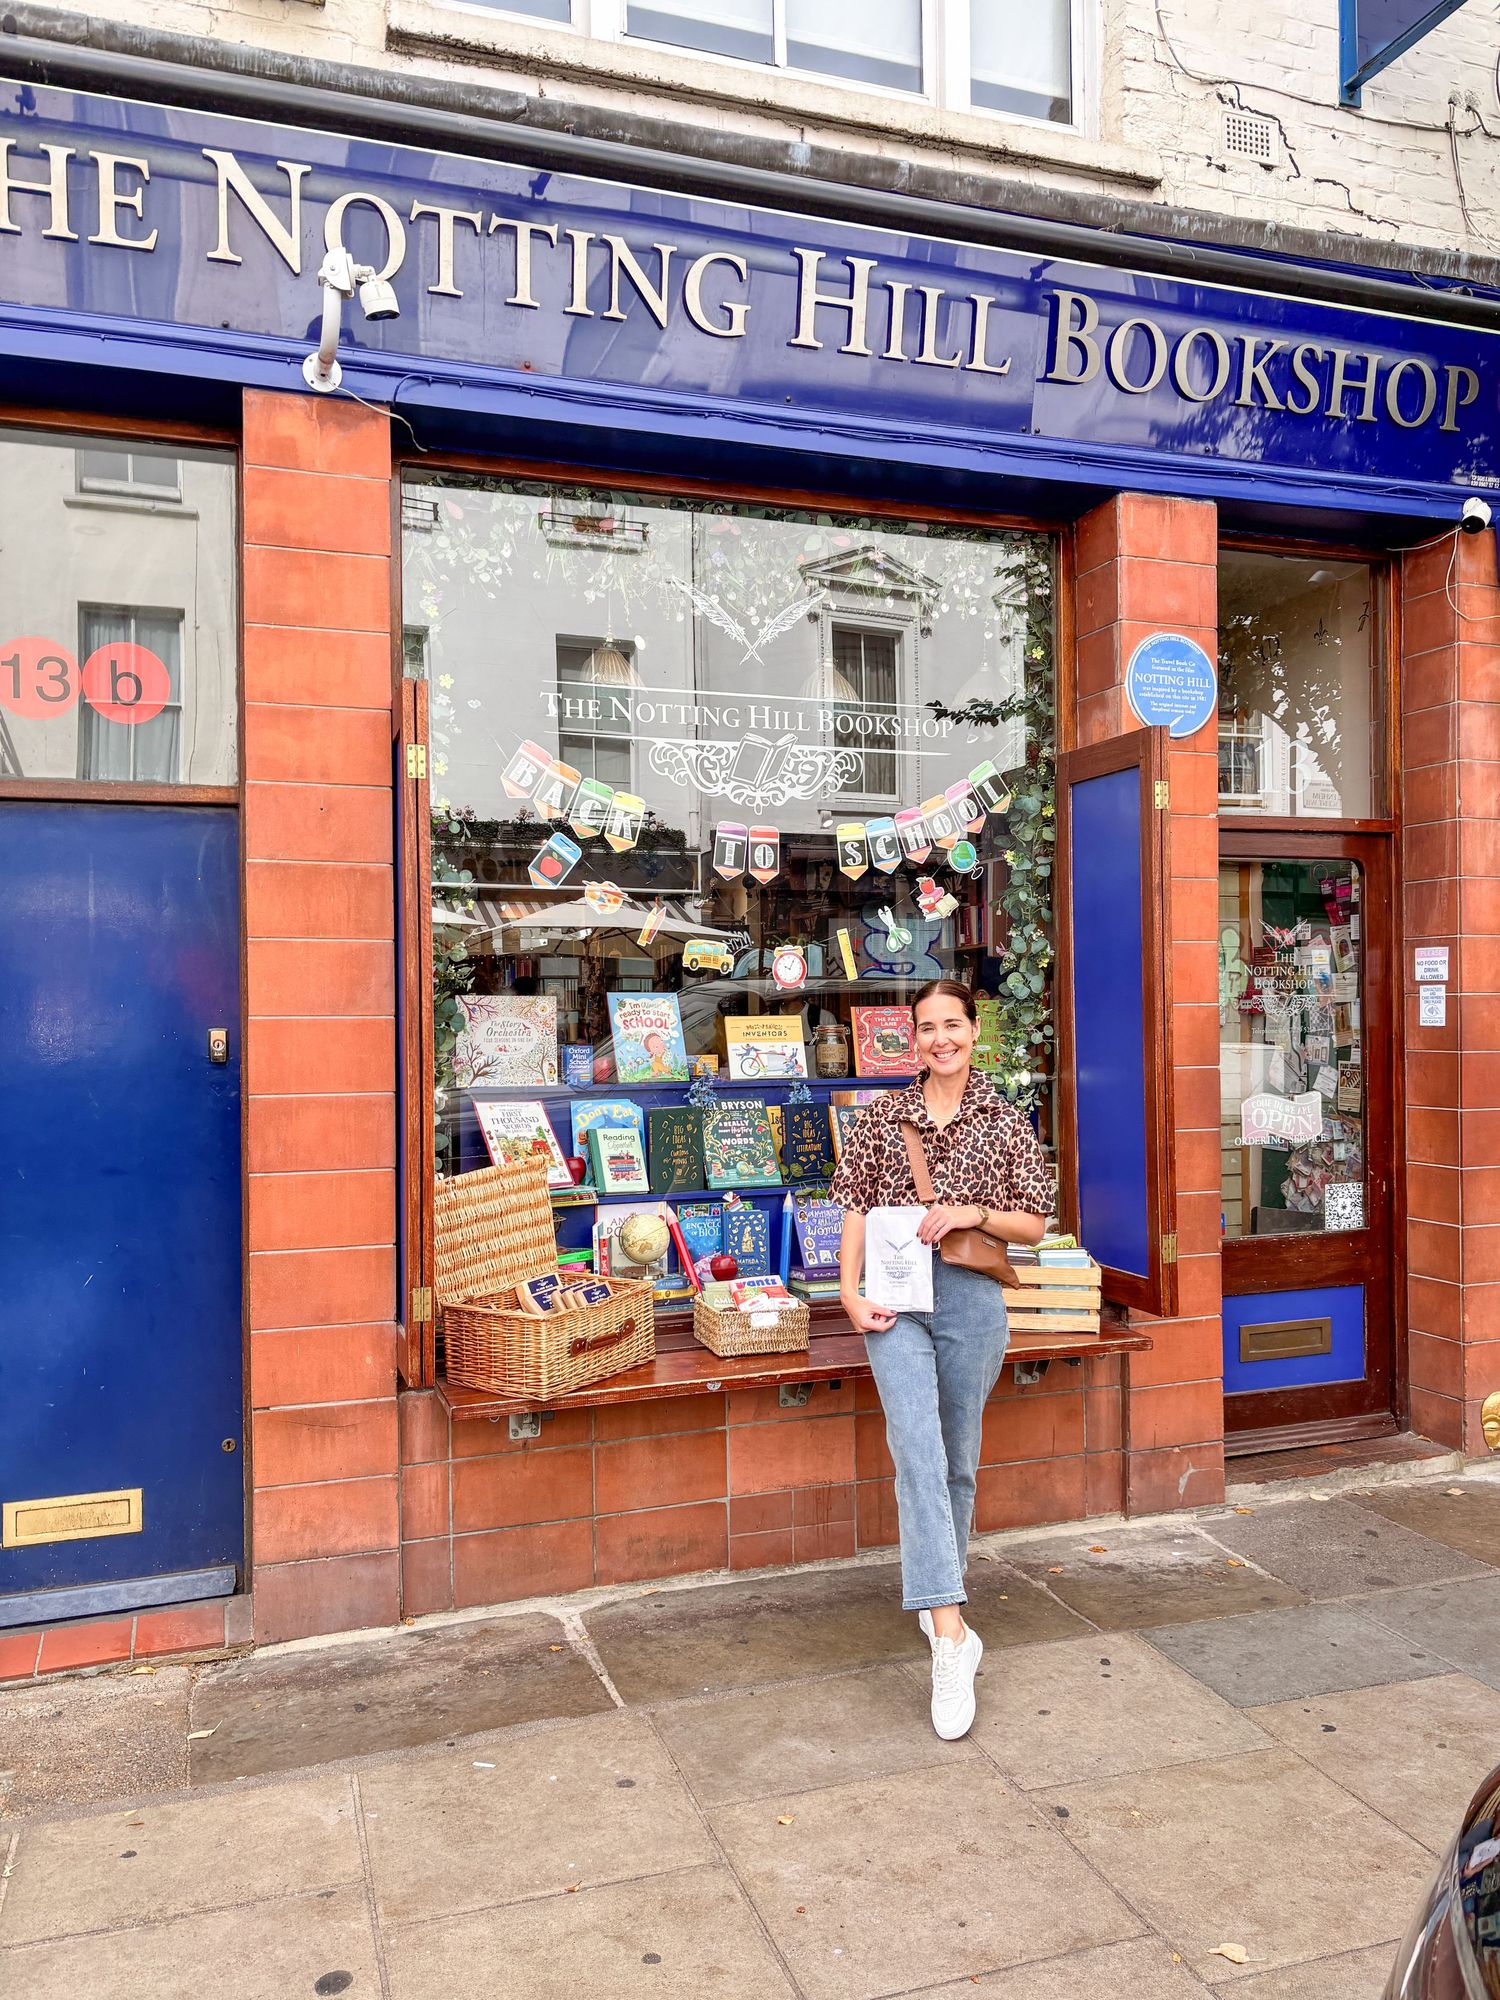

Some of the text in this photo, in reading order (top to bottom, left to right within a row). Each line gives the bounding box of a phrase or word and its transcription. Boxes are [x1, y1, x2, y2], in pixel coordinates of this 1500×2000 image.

[202, 148, 749, 338] NOTTING
[790, 248, 1012, 375] HILL
[1046, 289, 1480, 432] BOOKSHOP
[1151, 637, 1170, 645] NOTTING
[1151, 664, 1170, 672] featured
[1, 654, 142, 706] 13 b
[1135, 673, 1211, 688] NOTTING HILL
[1182, 688, 1204, 696] bookshop
[540, 692, 954, 739] THE NOTTING HILL BOOKSHOP
[1255, 738, 1312, 794] 13
[508, 756, 1005, 869] BACK TO SCHOOL
[1272, 951, 1295, 963] THE
[1244, 964, 1295, 976] NOTTING
[1254, 979, 1313, 990] BOOKSHOP
[619, 1009, 641, 1019] ready
[652, 1010, 671, 1020] start
[500, 1020, 521, 1030] Story
[622, 1017, 670, 1031] SCHOOL
[486, 1026, 531, 1037] Orchestra
[568, 1047, 590, 1055] Oxford
[721, 1100, 763, 1110] BRYSON
[491, 1116, 540, 1125] THOUSAND
[576, 1104, 609, 1127] Don't
[1251, 1108, 1313, 1134] OPEN
[673, 1124, 684, 1135] BIG
[803, 1120, 812, 1129] BIG
[602, 1133, 636, 1143] Reading
[802, 1129, 815, 1138] IDEAS
[672, 1134, 686, 1145] IDEAS
[721, 1137, 755, 1145] WORDS
[1234, 1133, 1327, 1146] ORDERING SERVICE
